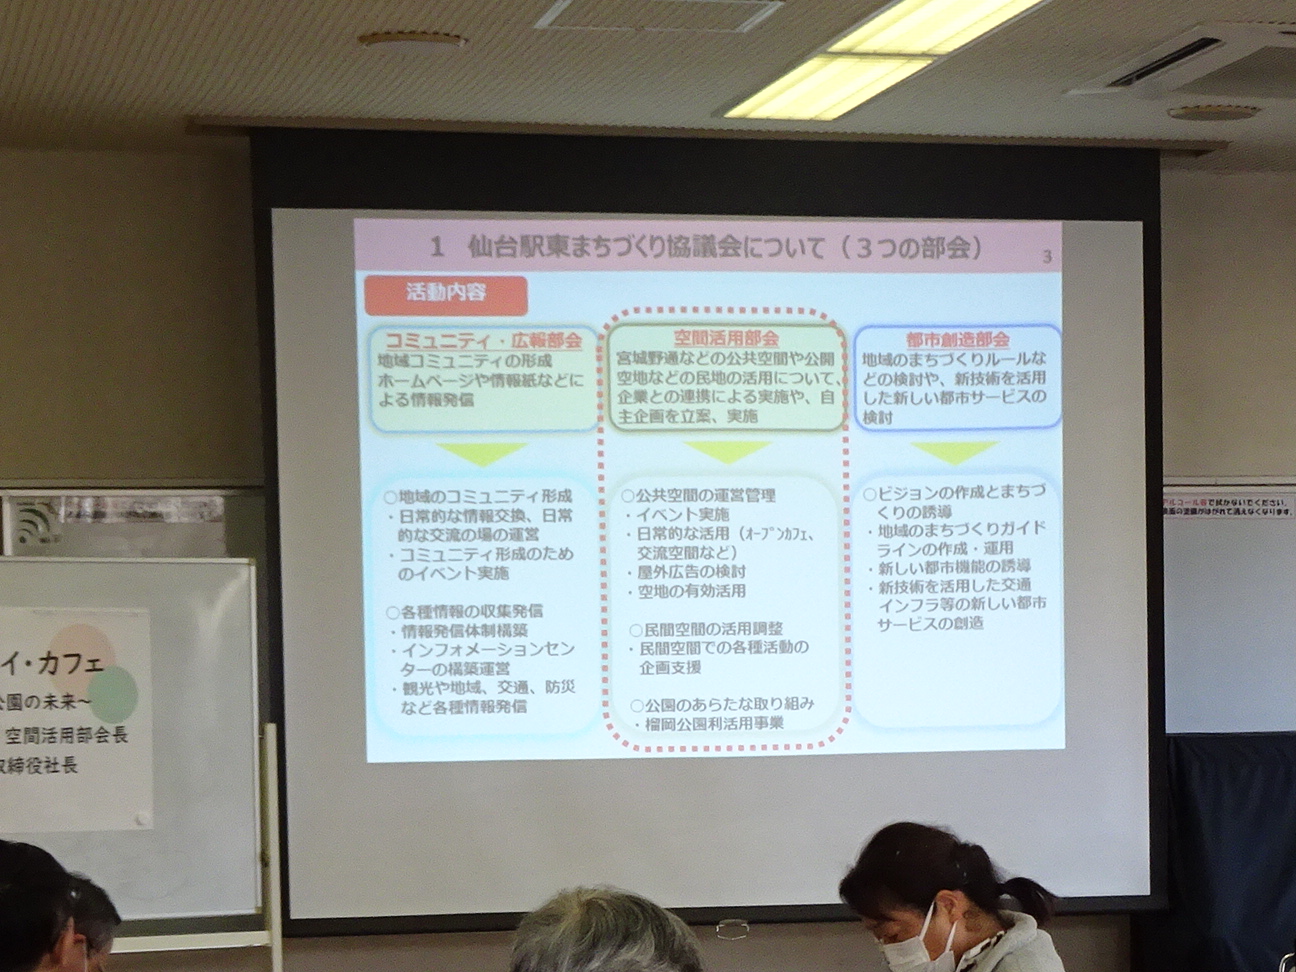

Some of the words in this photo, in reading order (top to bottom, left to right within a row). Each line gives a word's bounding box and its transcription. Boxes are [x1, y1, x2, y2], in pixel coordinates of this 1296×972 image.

[430, 235, 445, 257] 1
[1042, 250, 1053, 264] 3
[406, 282, 487, 302] 活動内容
[386, 332, 583, 349] コミュニティ・広報部会
[673, 329, 779, 347] 空間活用部会
[906, 331, 1011, 348] 都市創造部会
[377, 353, 553, 369] 地域コミュニティの形成
[616, 351, 835, 367] 宮城野通などの公共空間や公開
[862, 351, 1047, 368] 地域のまちづくりルールな
[378, 373, 584, 389] ホームページや情報紙などに
[617, 370, 842, 386] 空地などの民地の活用について、
[863, 370, 1047, 387] どの検討や、新技術を活用
[378, 392, 475, 408] よる情報発信
[617, 389, 835, 405] 企業との連携による実施や、自
[863, 389, 1047, 406] した新しい都市サービスの
[618, 409, 758, 424] 主企画を立案、実施
[862, 410, 893, 425] 検討
[878, 505, 953, 520] くりの誘導
[398, 527, 540, 543] 的な交流の場の運営
[637, 545, 738, 561] 交流空間など）
[877, 541, 1014, 558] ラインの作成・運用
[398, 566, 510, 581] のイベント実施
[879, 596, 1047, 613] インフラ等の新しい都市
[877, 616, 984, 633] サービスの創造
[400, 661, 511, 677] ターの構築運営
[640, 660, 702, 676] 企画支援
[401, 699, 528, 715] など各種情報発信
[5, 725, 129, 745] 空間活用部会長
